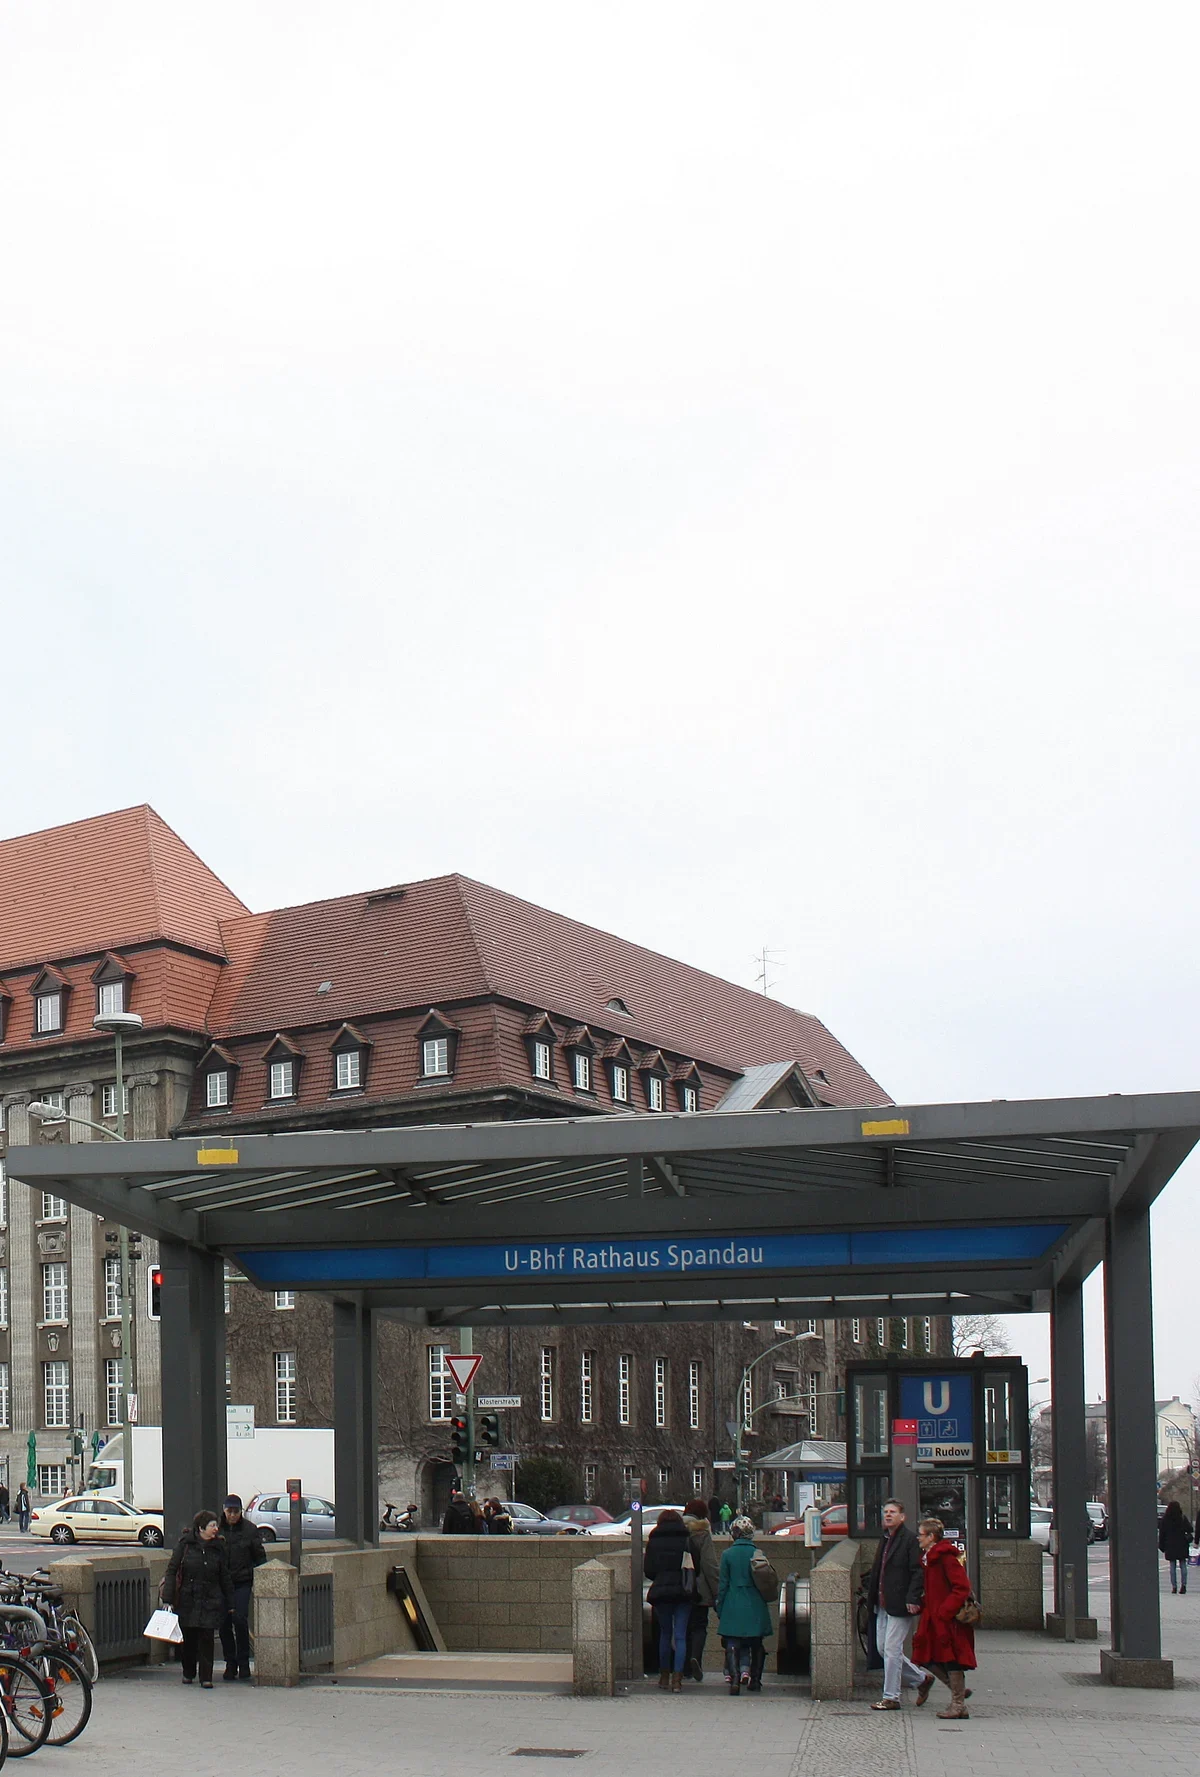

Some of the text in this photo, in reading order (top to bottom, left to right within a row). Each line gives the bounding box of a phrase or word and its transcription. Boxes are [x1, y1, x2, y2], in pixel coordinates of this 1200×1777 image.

[504, 1242, 763, 1271] U-Bhf Rathaus Spandau
[479, 1398, 519, 1406] Klosterstraße
[923, 1380, 950, 1415] U
[918, 1447, 970, 1457] U7 Rudow
